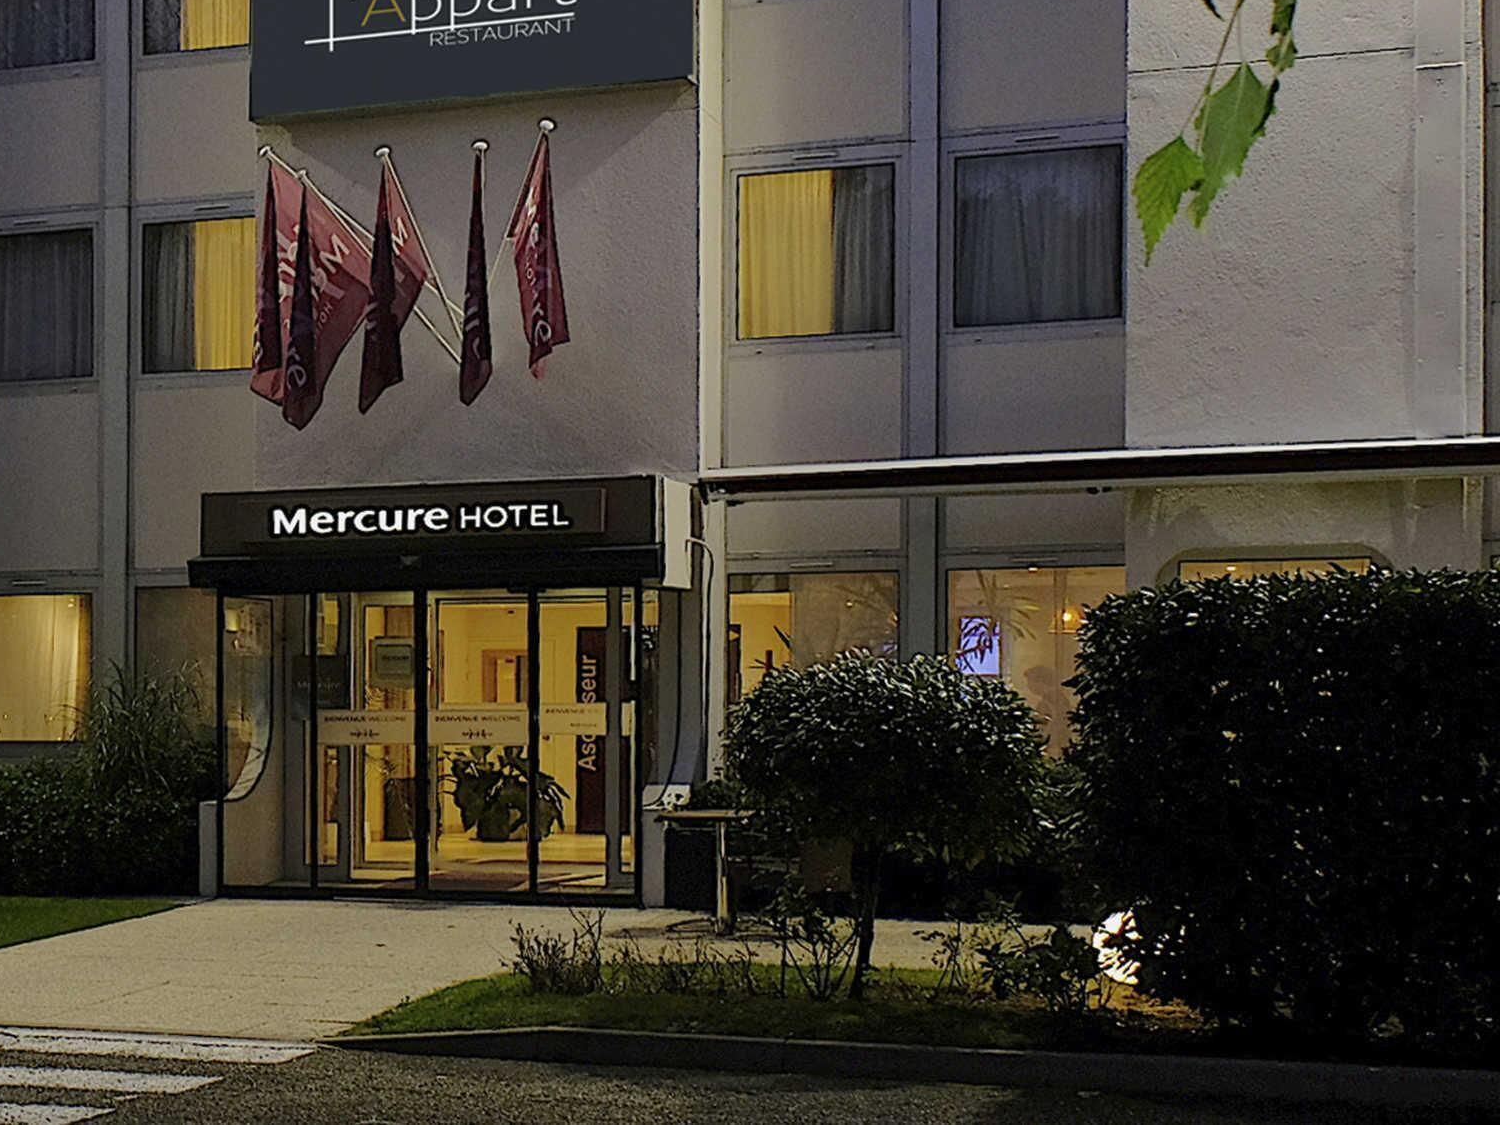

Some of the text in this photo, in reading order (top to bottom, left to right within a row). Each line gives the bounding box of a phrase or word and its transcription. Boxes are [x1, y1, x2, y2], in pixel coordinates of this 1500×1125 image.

[429, 18, 574, 48] RESTAURANT
[272, 504, 570, 535] Mercure HOTEL
[577, 654, 597, 772] Ascseur
